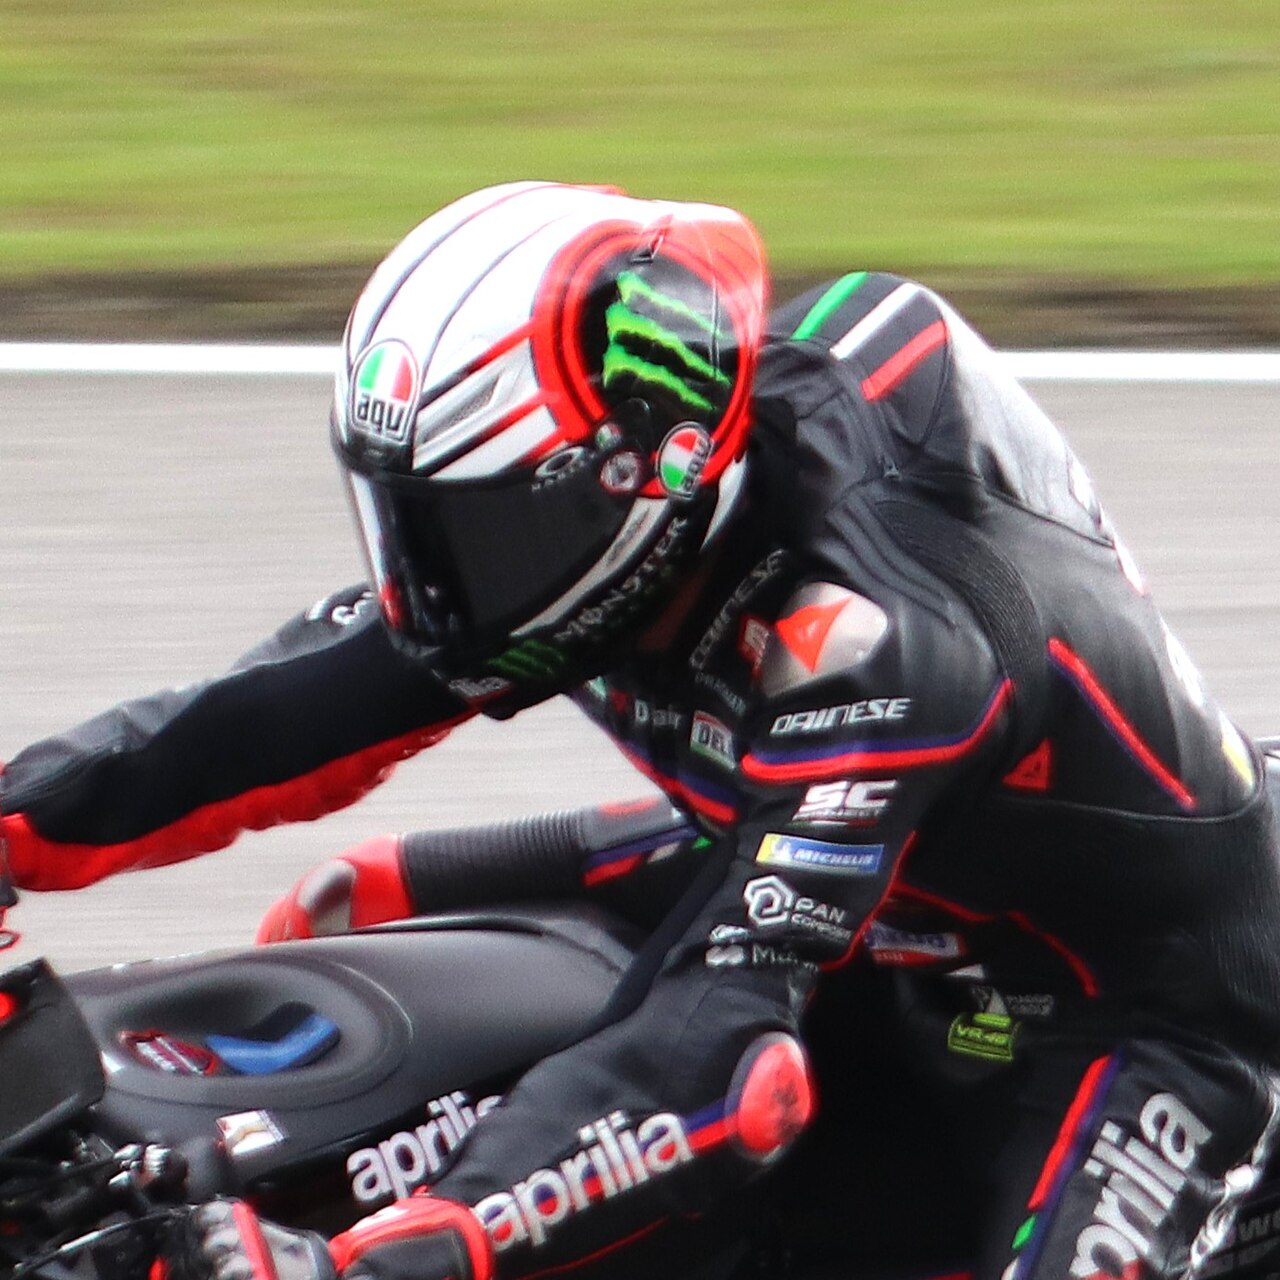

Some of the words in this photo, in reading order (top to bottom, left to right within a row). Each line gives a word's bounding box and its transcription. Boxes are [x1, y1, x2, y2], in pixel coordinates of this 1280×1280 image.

[770, 698, 910, 735] DAINESE
[795, 779, 899, 816] SC
[794, 896, 848, 924] PAN
[473, 1107, 697, 1254] aprilia
